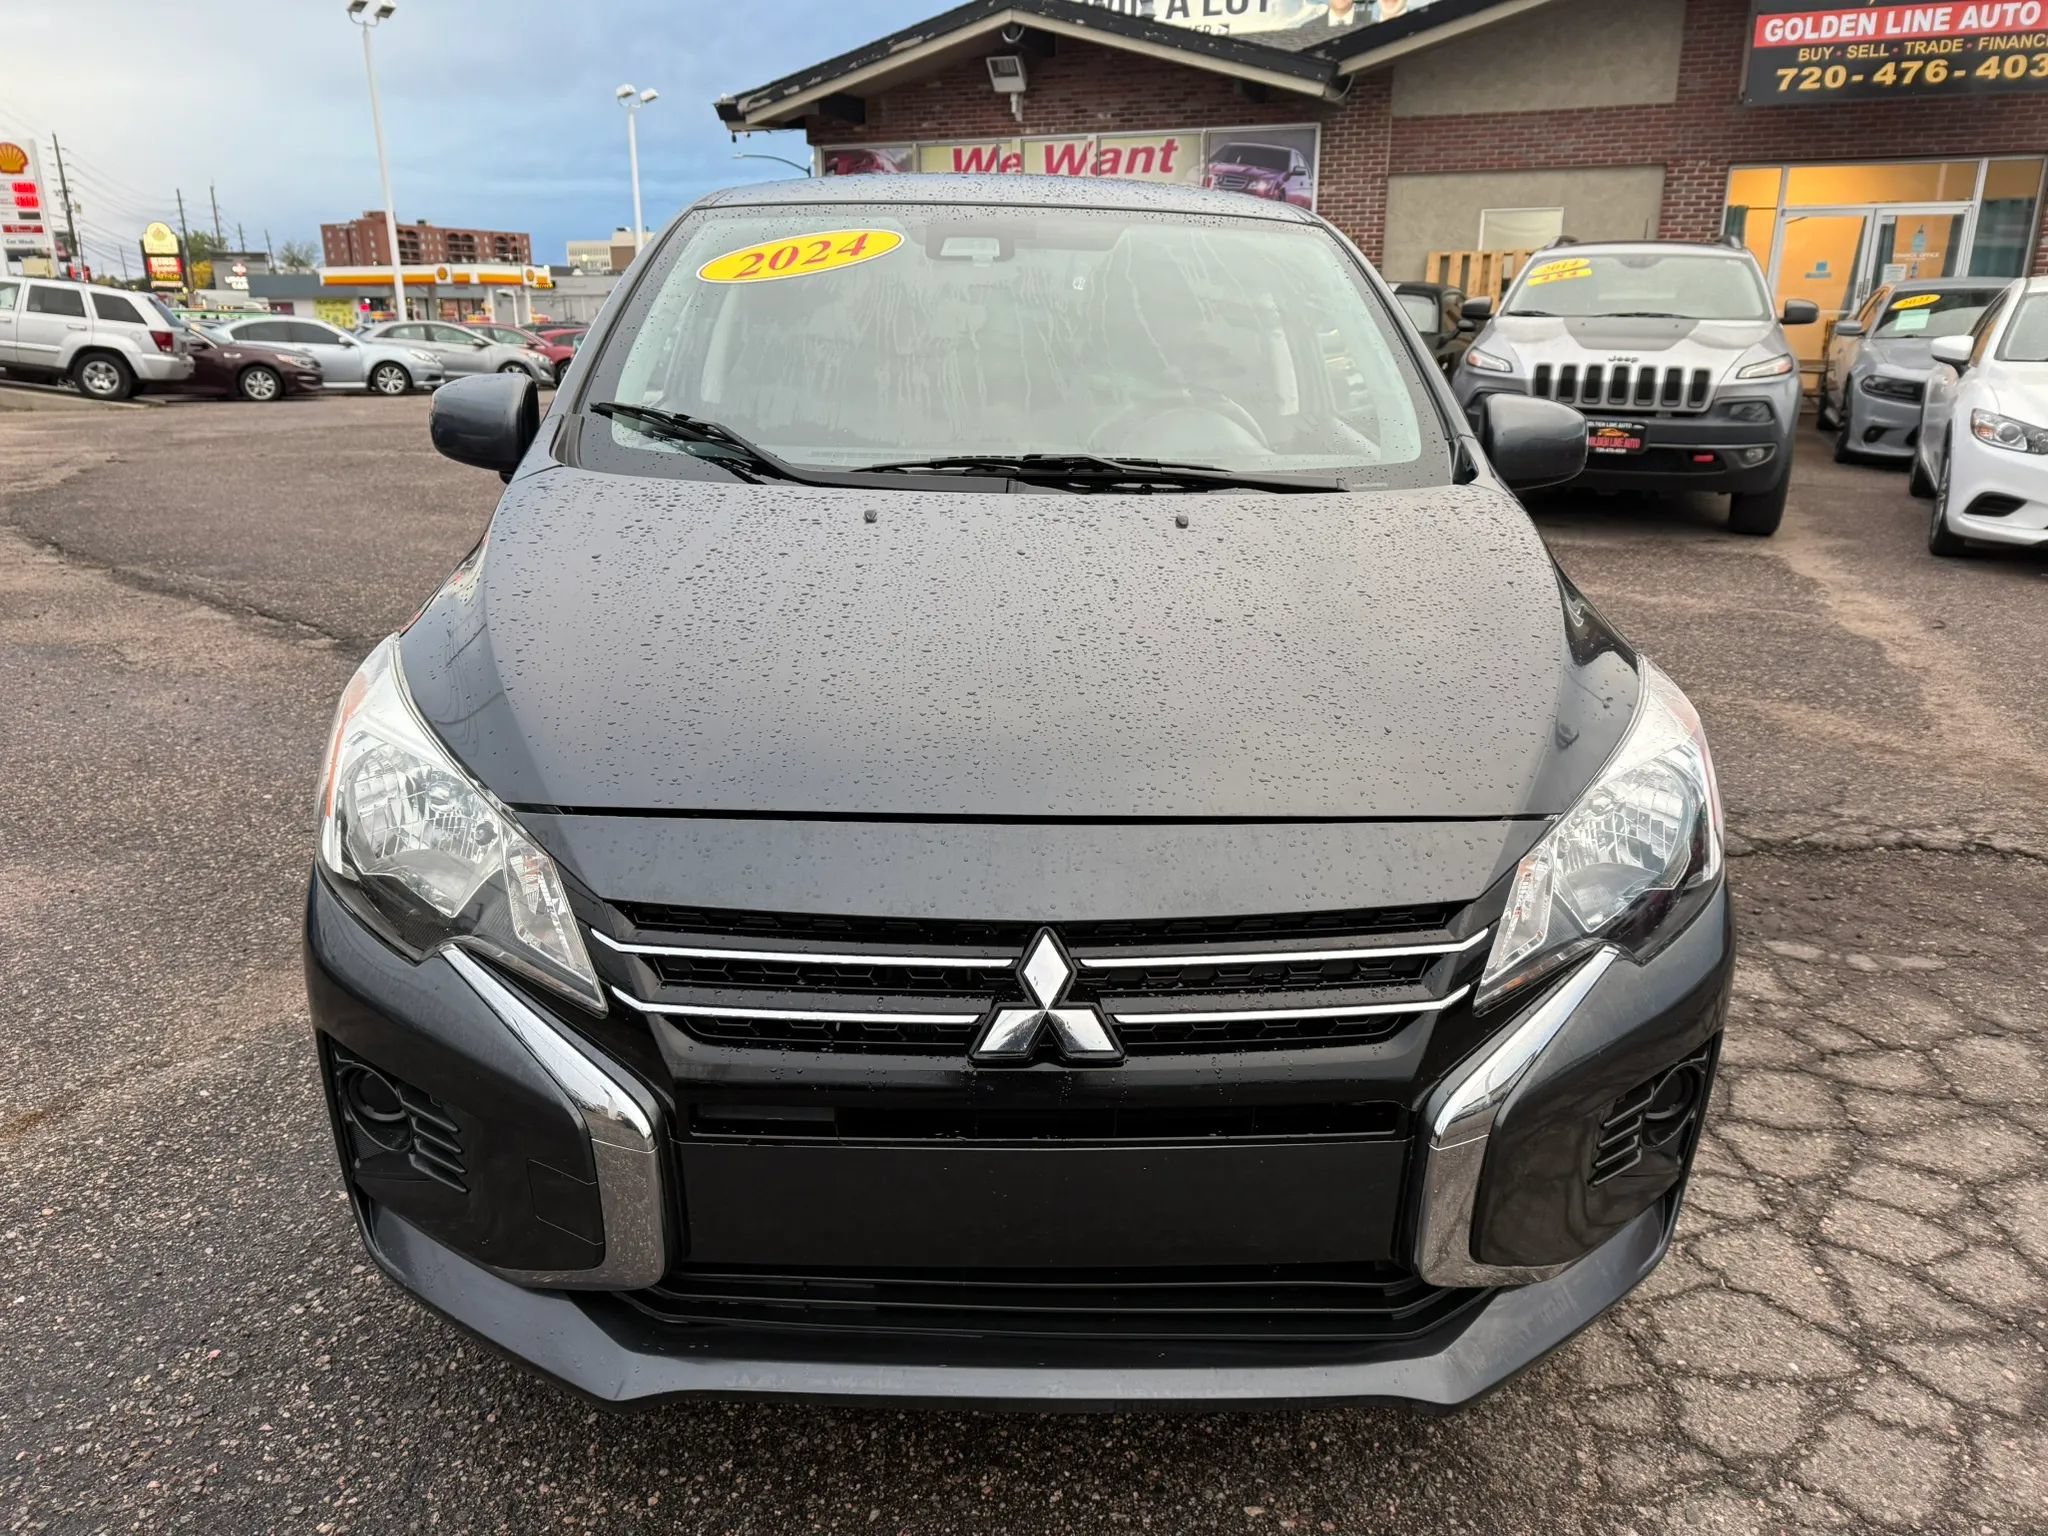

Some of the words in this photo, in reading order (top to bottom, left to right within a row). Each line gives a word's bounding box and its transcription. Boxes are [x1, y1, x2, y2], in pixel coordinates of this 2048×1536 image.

[1764, 12, 1878, 42] GOLDEN
[1884, 7, 1953, 35] LINE
[1958, 1, 2042, 29] AUTO
[1798, 46, 1835, 61] BUY
[1846, 43, 1890, 58] SELL
[1903, 38, 1964, 55] TRADE
[1977, 33, 2048, 51] FINANC
[953, 146, 1024, 173] We
[1044, 138, 1178, 176] Want
[732, 232, 869, 279] 2024
[1608, 355, 1639, 364] Jeep
